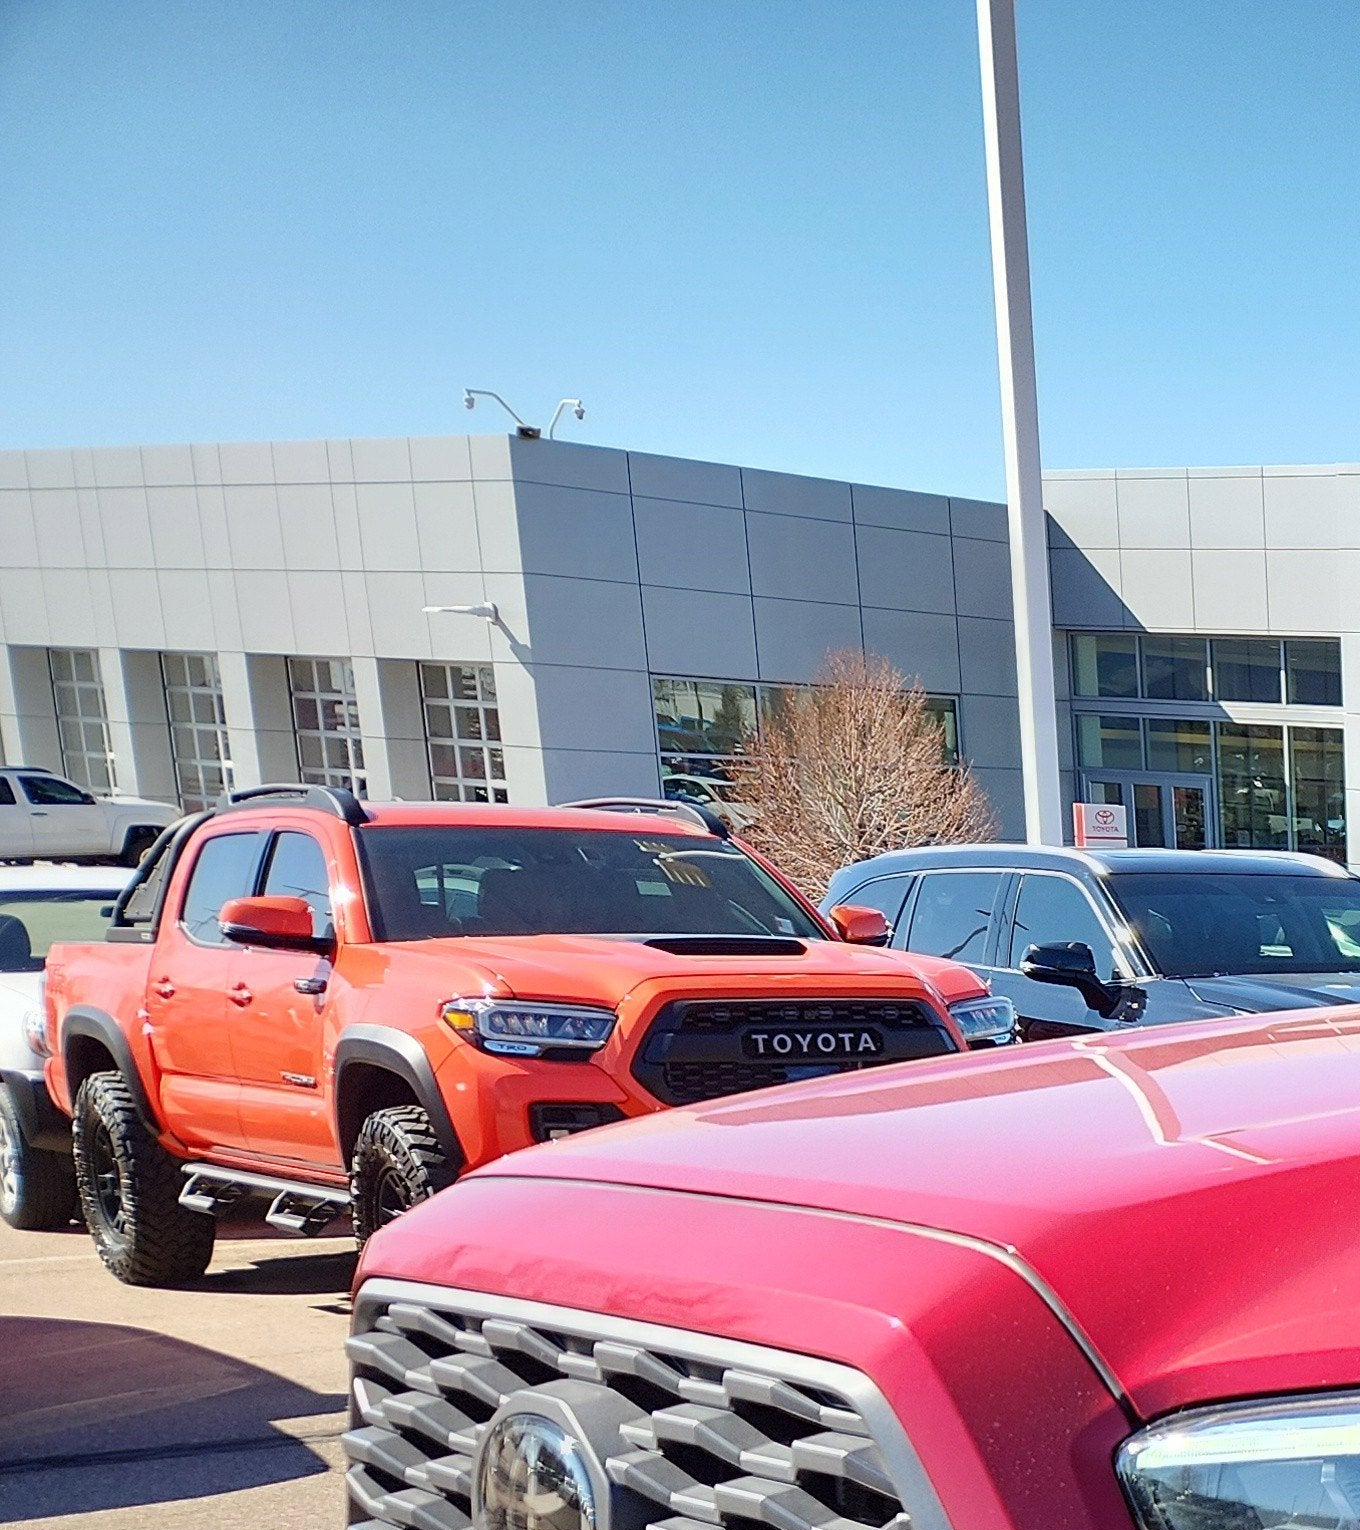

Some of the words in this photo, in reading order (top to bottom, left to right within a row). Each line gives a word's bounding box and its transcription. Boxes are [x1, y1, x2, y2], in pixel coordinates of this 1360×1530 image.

[1092, 825, 1120, 833] TOYOTA
[498, 1043, 528, 1051] TRD
[751, 1033, 877, 1054] TOYOTA
